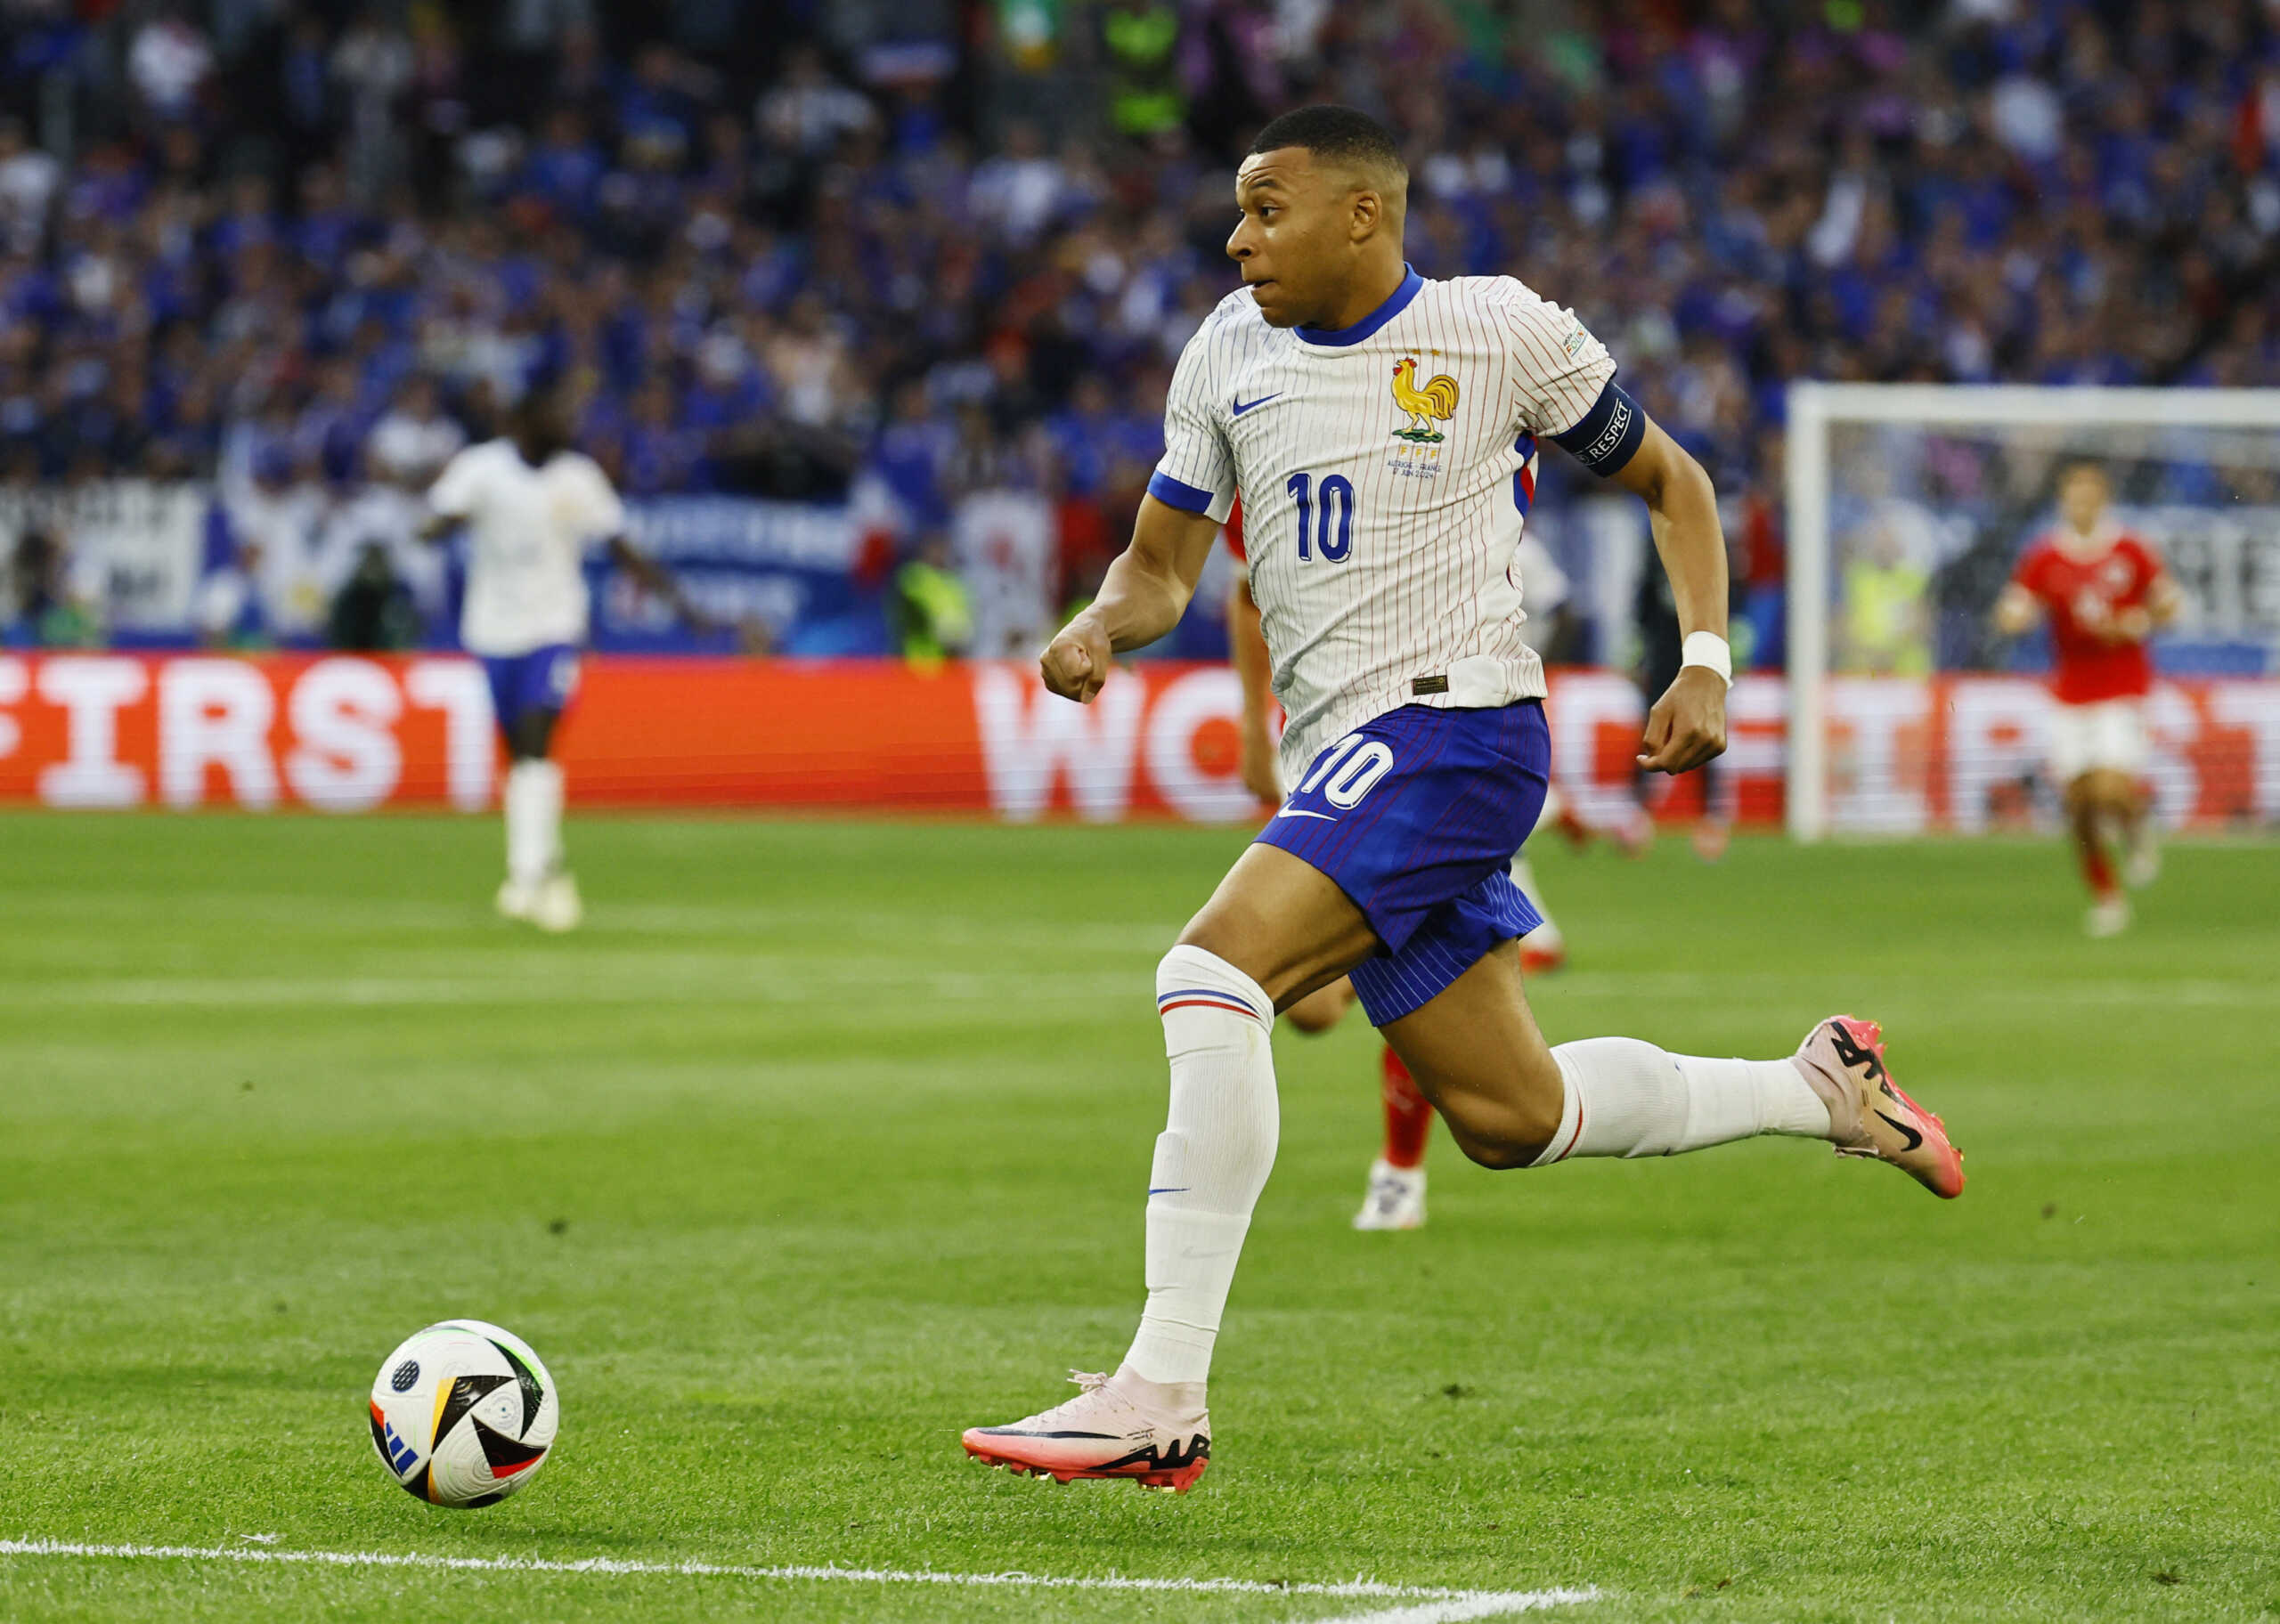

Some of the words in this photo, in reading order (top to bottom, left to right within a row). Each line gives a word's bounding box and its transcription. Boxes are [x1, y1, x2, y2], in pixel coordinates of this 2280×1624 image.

[1589, 401, 1629, 459] RESPECT
[1287, 473, 1356, 564] 10
[1300, 733, 1394, 810] 10
[1084, 1433, 1210, 1471] AIR
